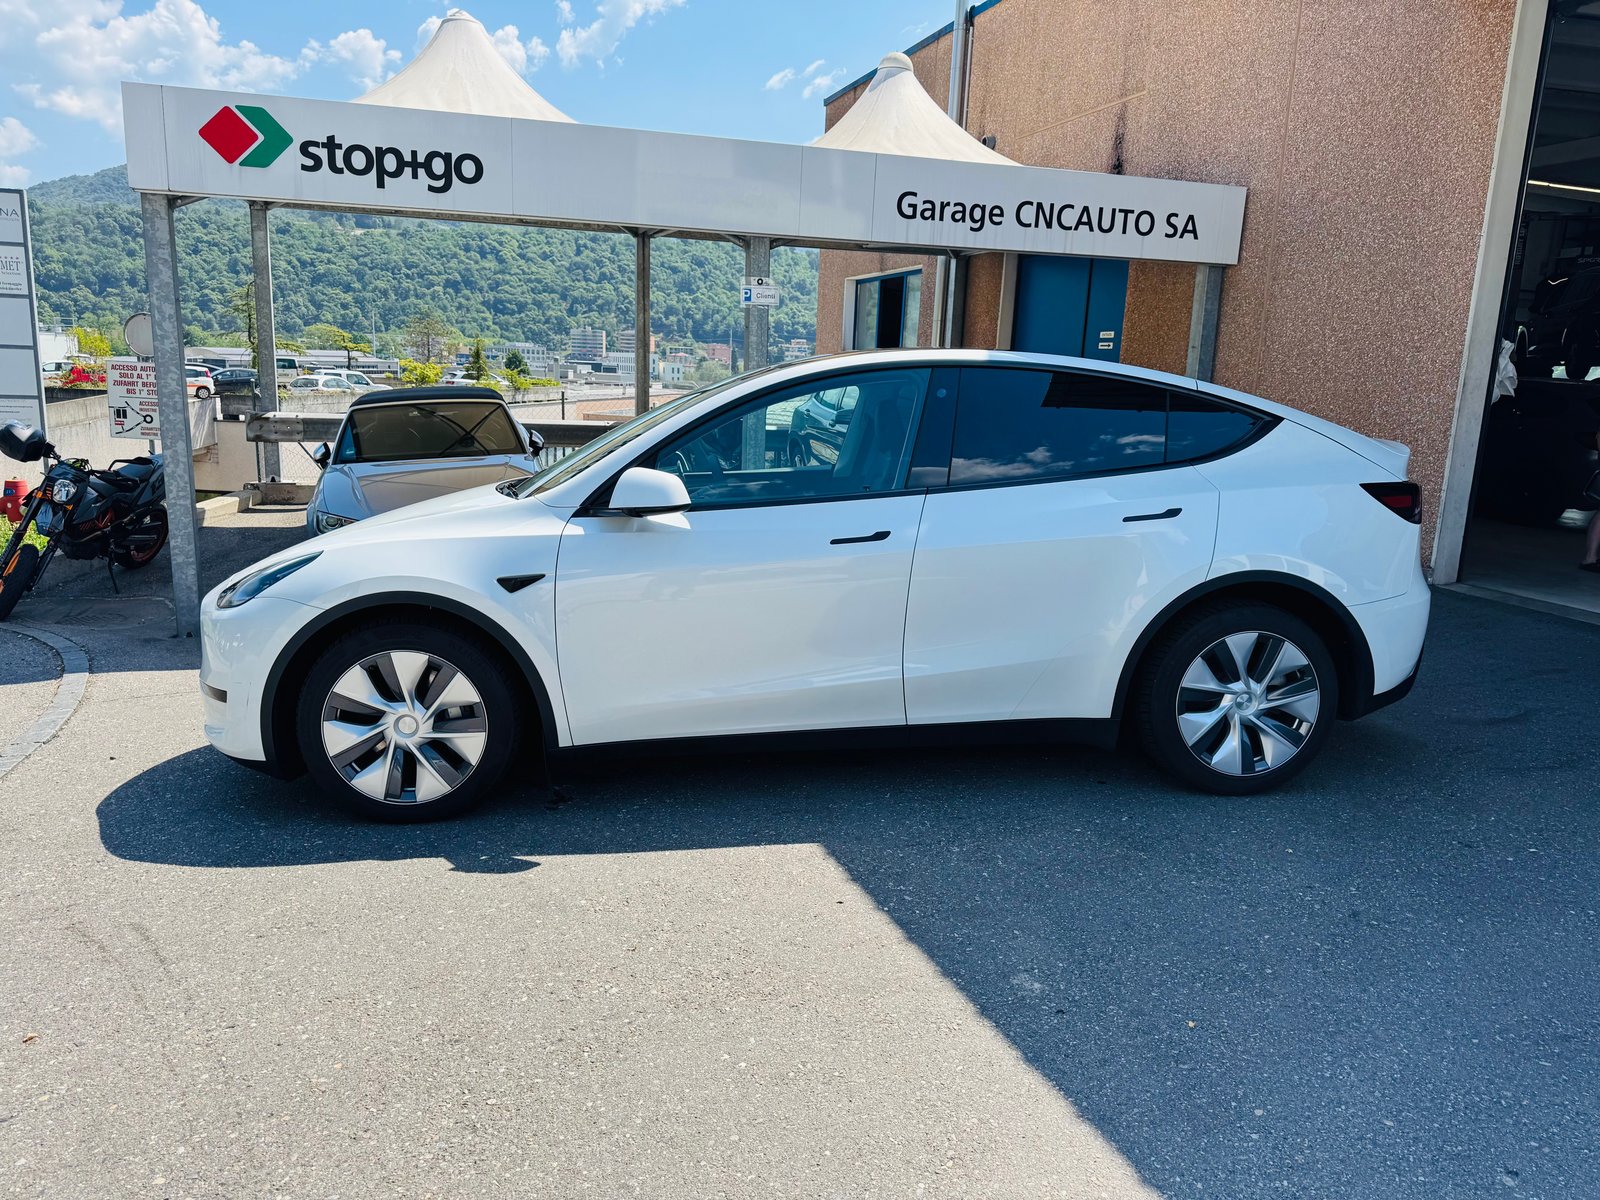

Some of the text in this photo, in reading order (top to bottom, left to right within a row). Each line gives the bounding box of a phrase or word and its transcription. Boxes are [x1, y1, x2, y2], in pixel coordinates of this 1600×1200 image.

[300, 135, 484, 193] stop+go
[896, 191, 1199, 240] Garage CNCAUTO SA
[113, 380, 139, 388] ZUFAHRT
